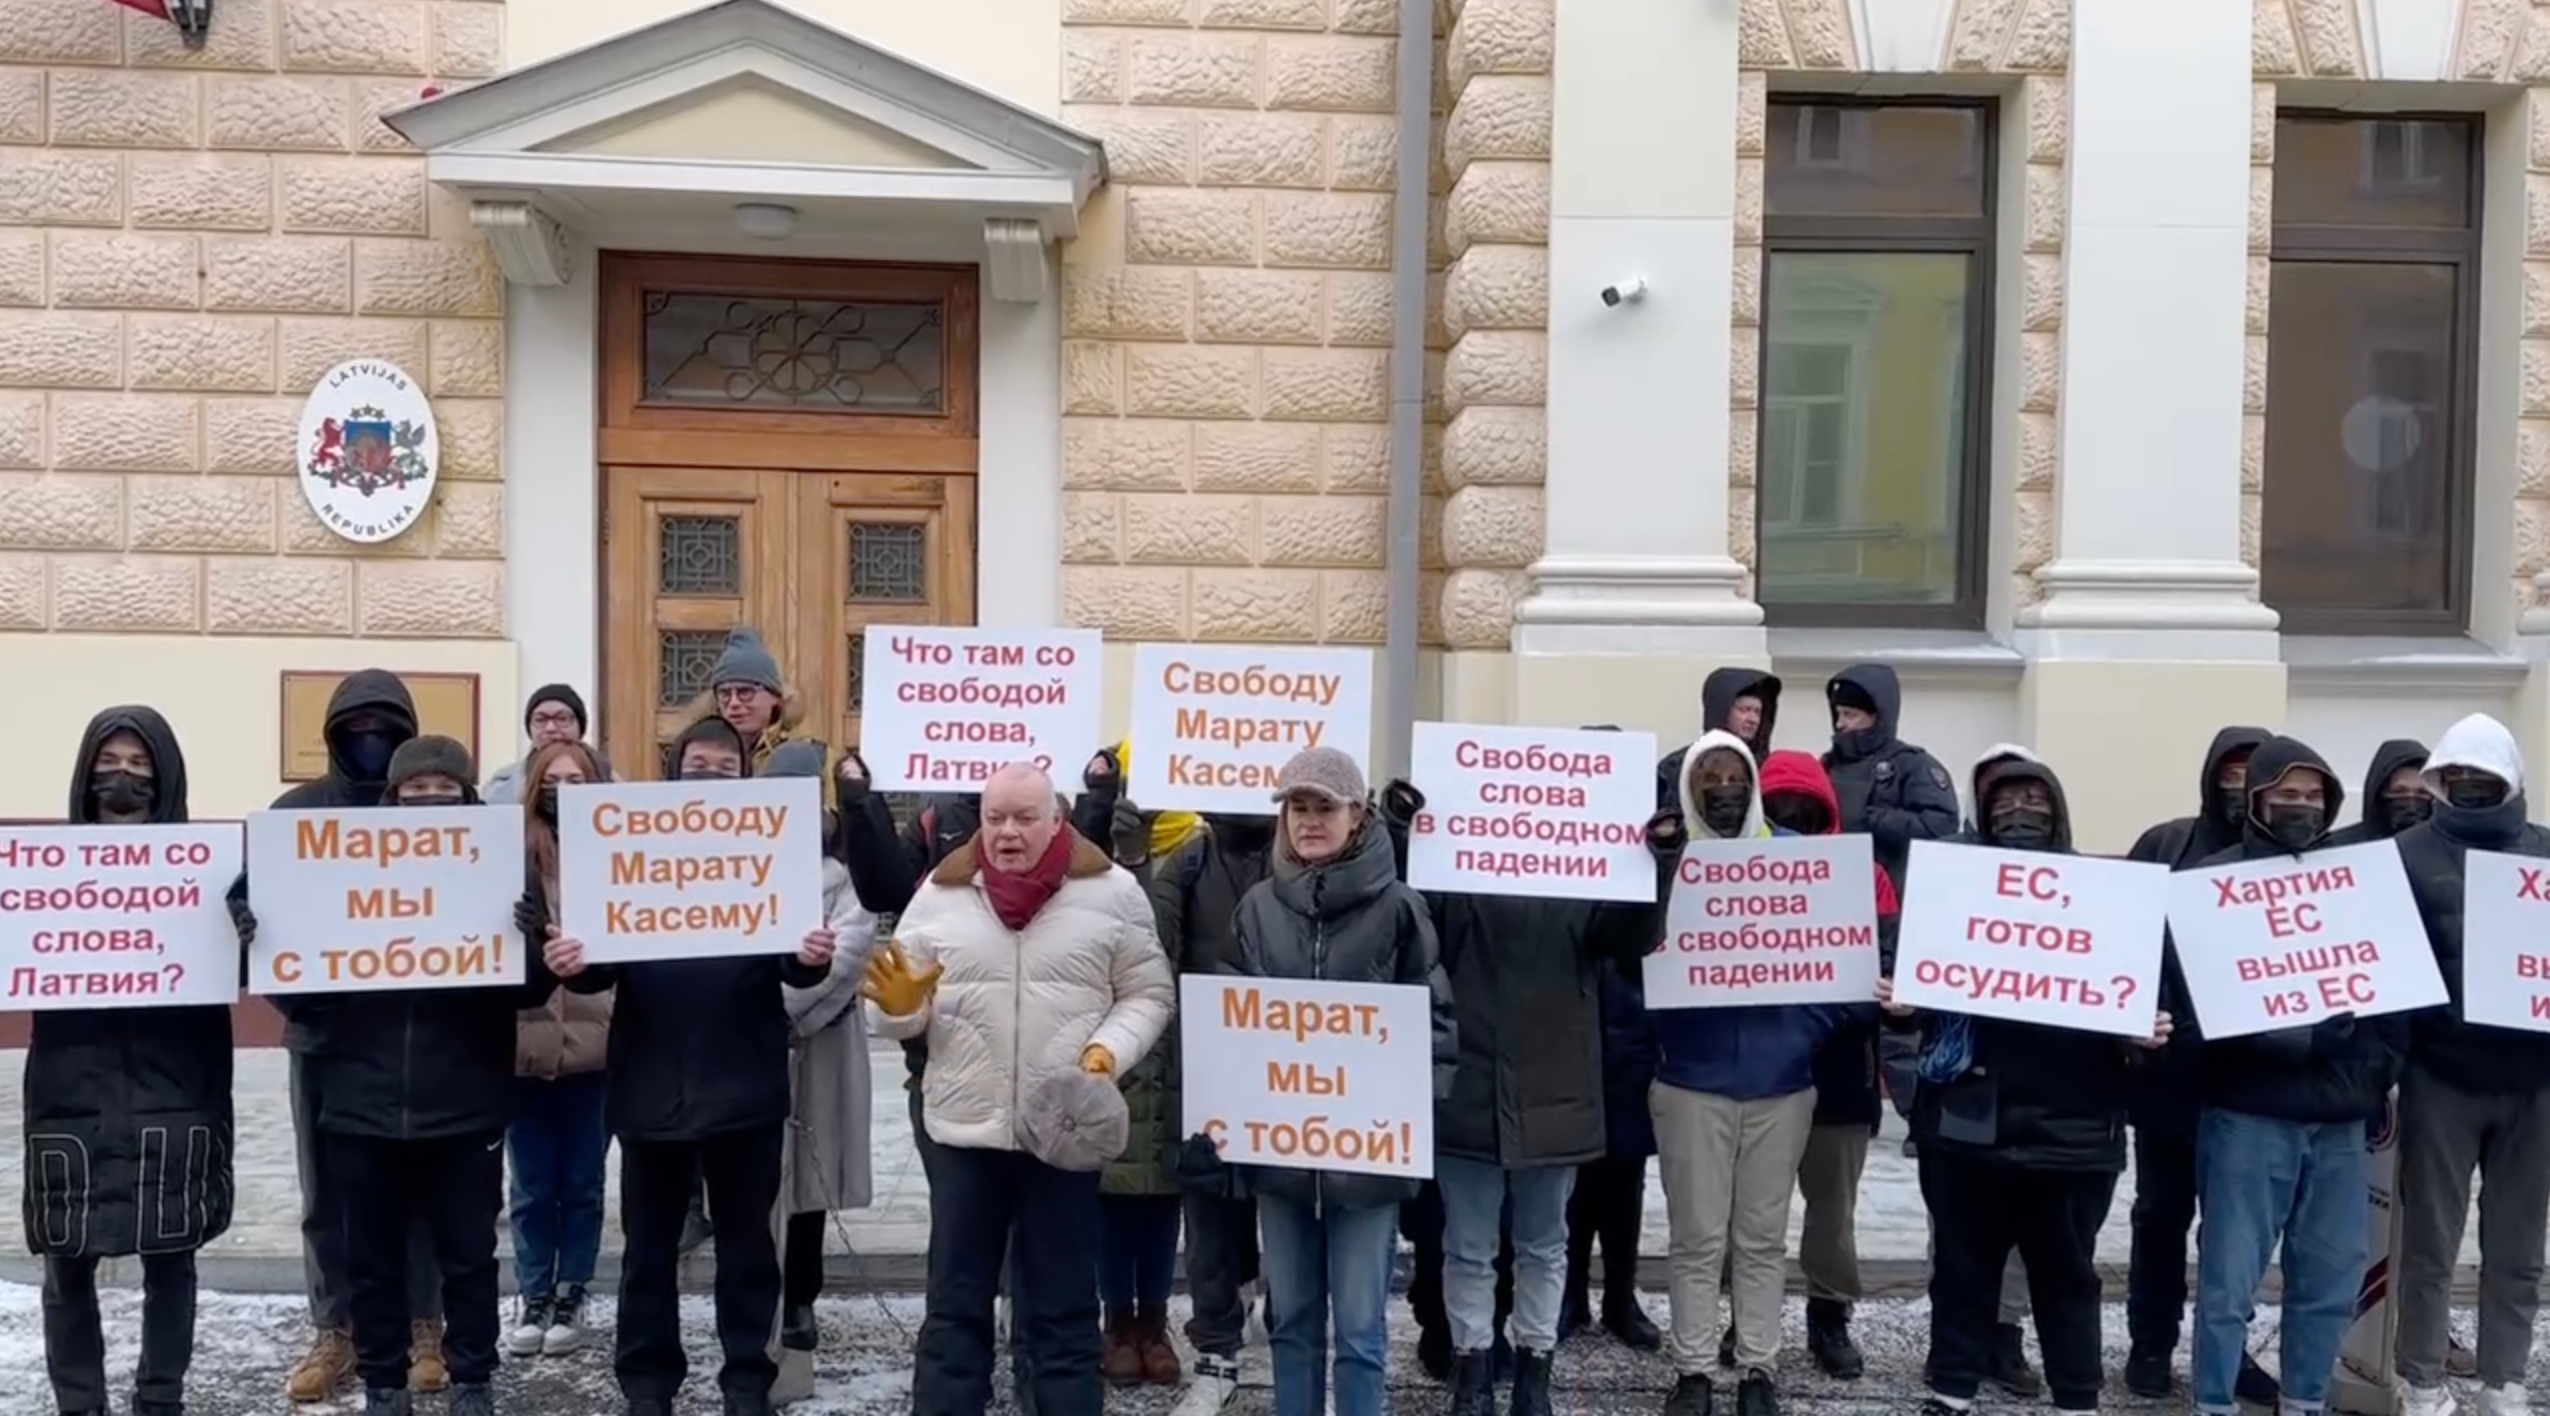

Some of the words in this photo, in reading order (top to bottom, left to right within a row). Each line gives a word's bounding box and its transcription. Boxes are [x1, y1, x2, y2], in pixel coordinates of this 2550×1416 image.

[329, 365, 408, 390] LATVIJAS
[321, 502, 414, 537] REPUBLIKA
[891, 637, 953, 664] Что
[962, 645, 1024, 665] там
[1036, 647, 1075, 666] со
[897, 677, 1066, 708] свободой
[1164, 662, 1342, 705] Свободу
[925, 721, 1036, 747] слова,
[1176, 709, 1324, 749] Марату
[1456, 740, 1612, 778] Свобода
[1480, 783, 1586, 807] слова
[592, 800, 788, 839] Свободу
[1416, 813, 1436, 834] в
[1447, 812, 1648, 846] свободном
[0, 839, 66, 868] Что
[78, 843, 151, 867] там
[165, 842, 211, 866] со
[297, 819, 479, 869] Марат,
[611, 851, 773, 890] Марату
[1455, 850, 1608, 877] падении
[1680, 855, 1831, 885] Свобода
[0, 879, 200, 913] свободой
[1997, 863, 2071, 907] ЕС,
[2211, 864, 2355, 908] Хартия
[347, 888, 433, 919] мы
[606, 894, 778, 935] Касему!
[1704, 893, 1808, 918] слова
[2266, 902, 2322, 937] ЕС
[32, 928, 165, 955] слова,
[1677, 922, 1873, 953] свободном
[1967, 917, 2093, 954] готов
[273, 952, 302, 983] с
[320, 934, 504, 980] тобой!
[1688, 961, 1834, 989] падении
[2237, 940, 2379, 982] вышла
[8, 963, 185, 997] Латвия?
[1914, 960, 2137, 1010] осудить?
[2264, 991, 2310, 1017] из
[2316, 973, 2376, 1008] ЕС
[1222, 987, 1389, 1044] Марат,
[1266, 1061, 1346, 1096] мы
[1243, 1116, 1412, 1165] тобой!
